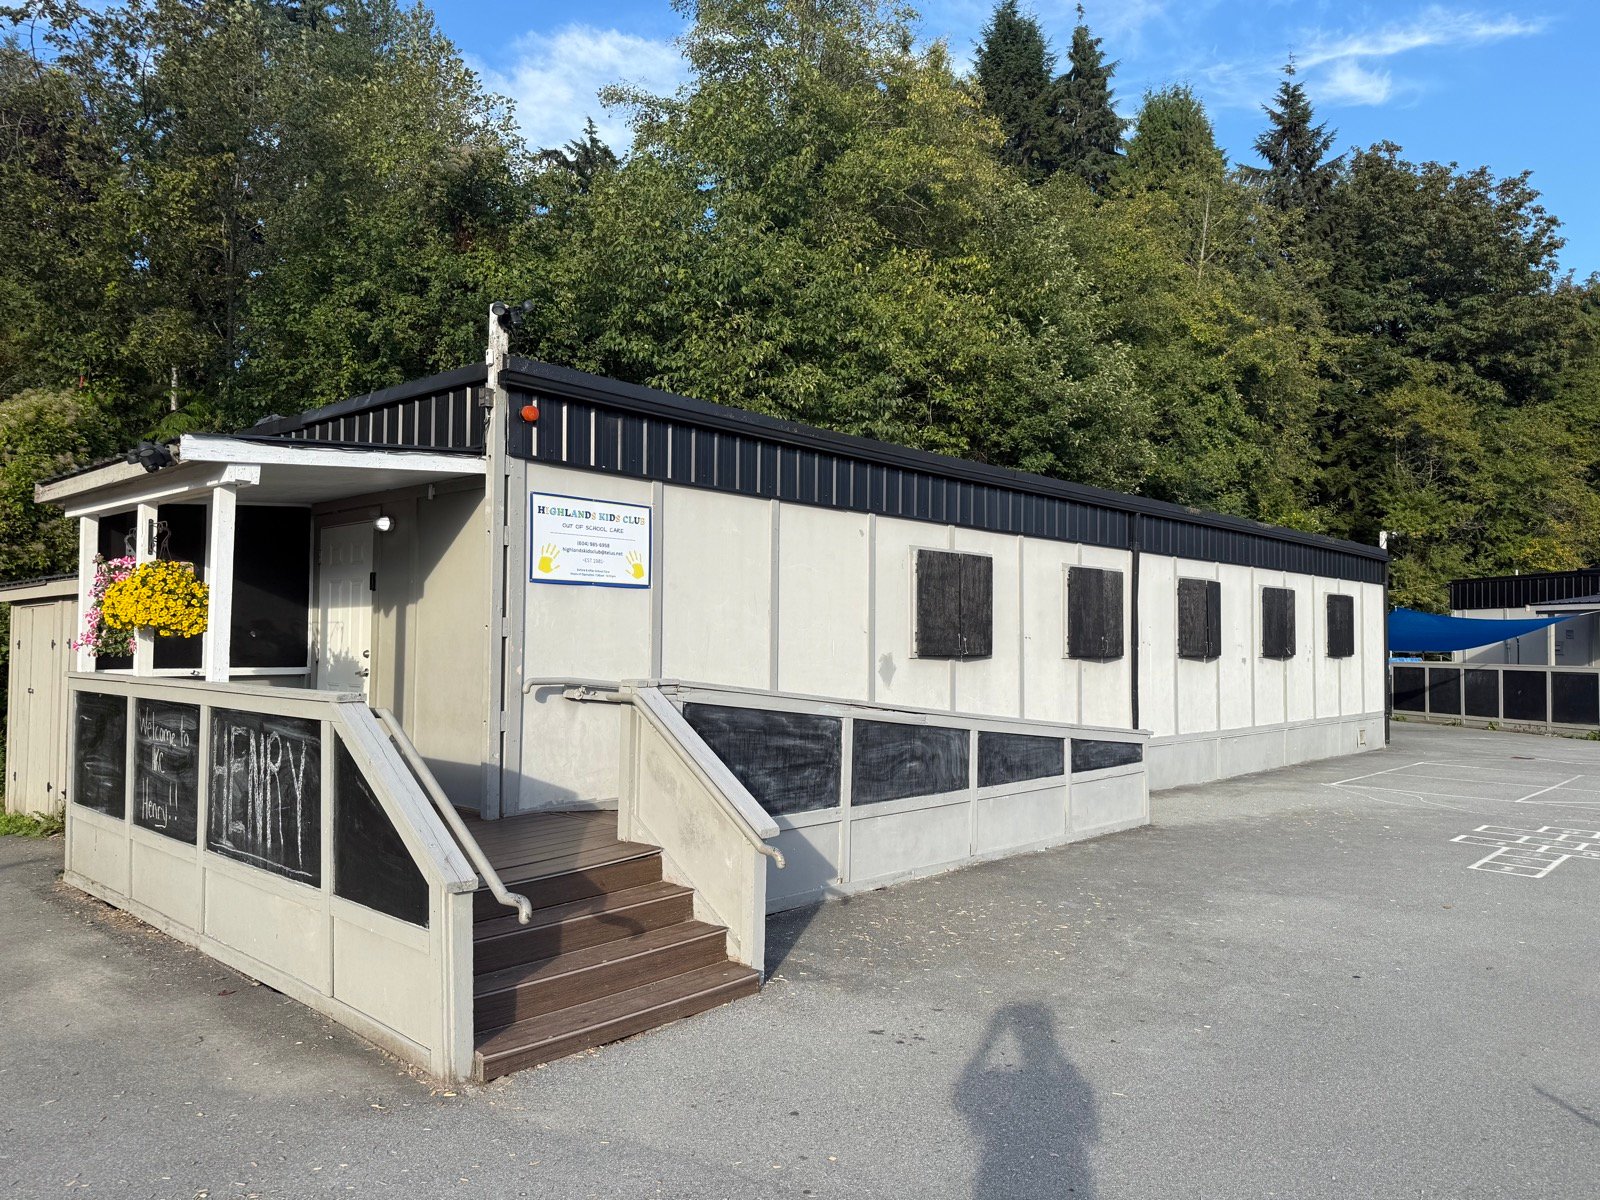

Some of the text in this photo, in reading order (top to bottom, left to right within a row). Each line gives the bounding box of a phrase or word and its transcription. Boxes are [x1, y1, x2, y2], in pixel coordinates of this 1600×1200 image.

[537, 505, 645, 525] HIGHLANDS KIDS CLUB
[585, 525, 607, 533] SCHOOL
[138, 705, 190, 748] Welcome to
[210, 716, 307, 870] HENRY
